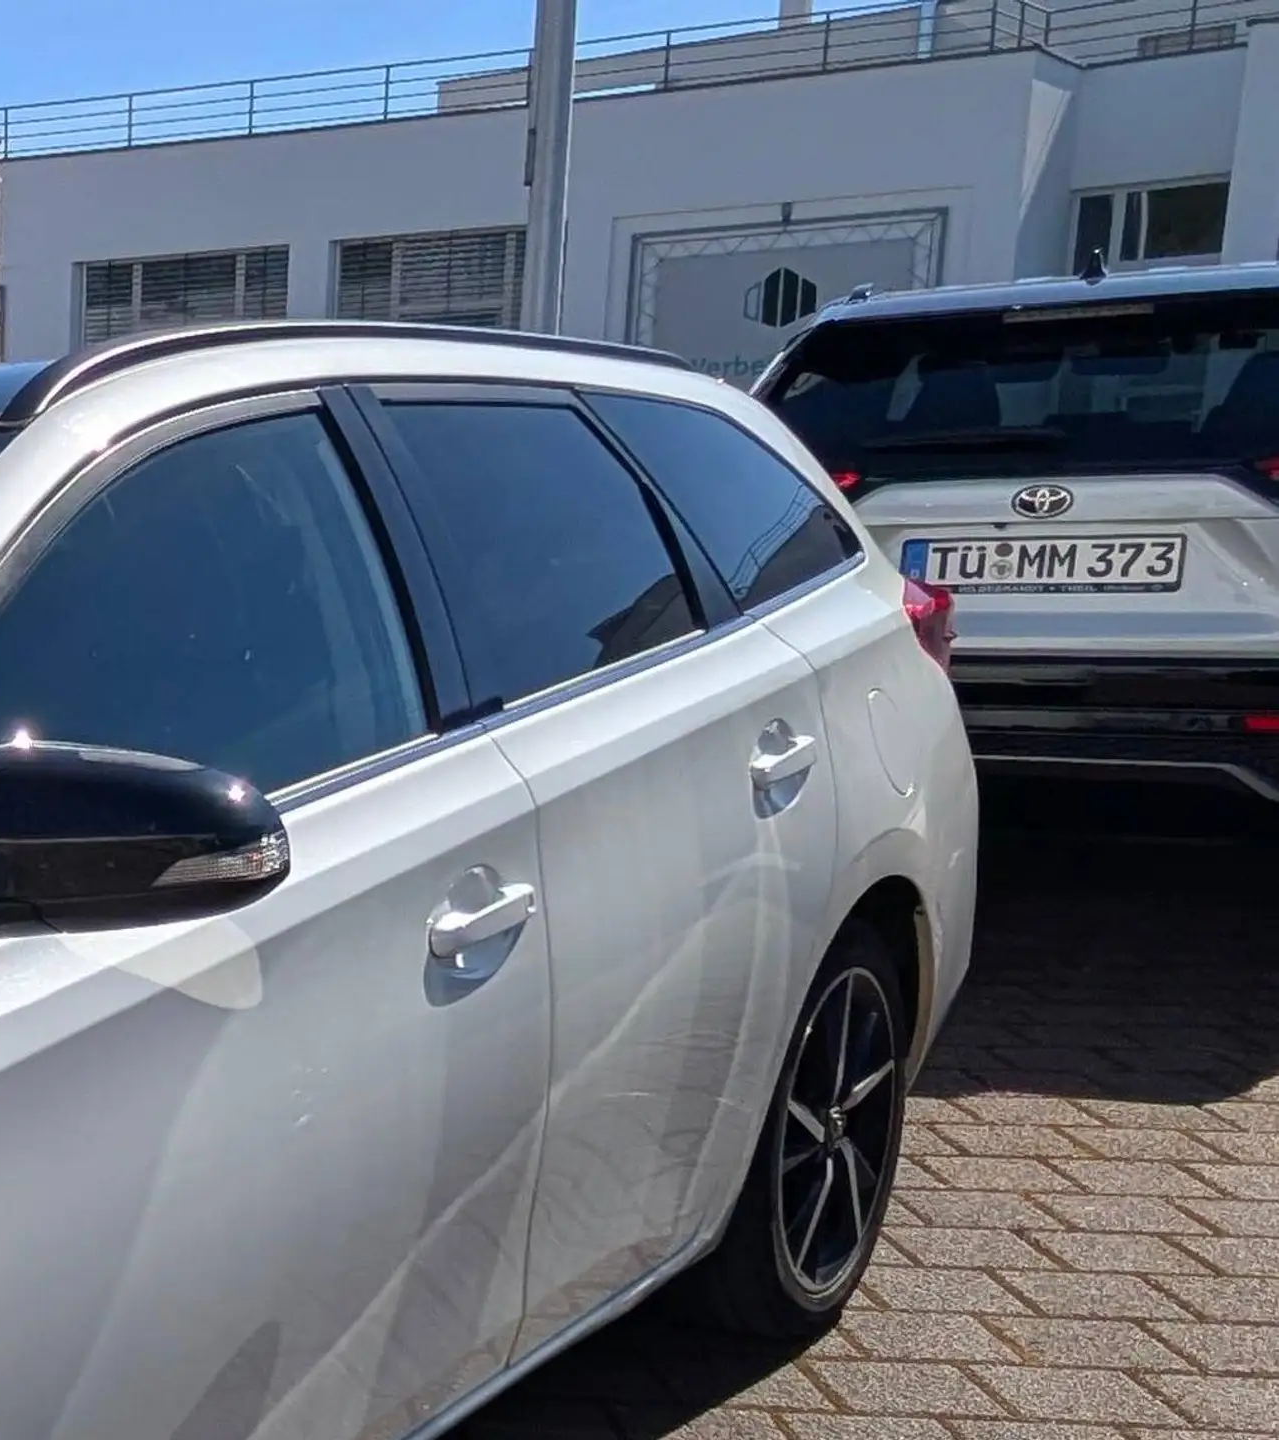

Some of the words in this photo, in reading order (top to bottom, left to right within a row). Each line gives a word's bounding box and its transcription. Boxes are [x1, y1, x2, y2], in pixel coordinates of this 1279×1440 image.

[932, 543, 987, 580] TÜ
[1016, 543, 1078, 579] MM
[1087, 541, 1175, 578] 373
